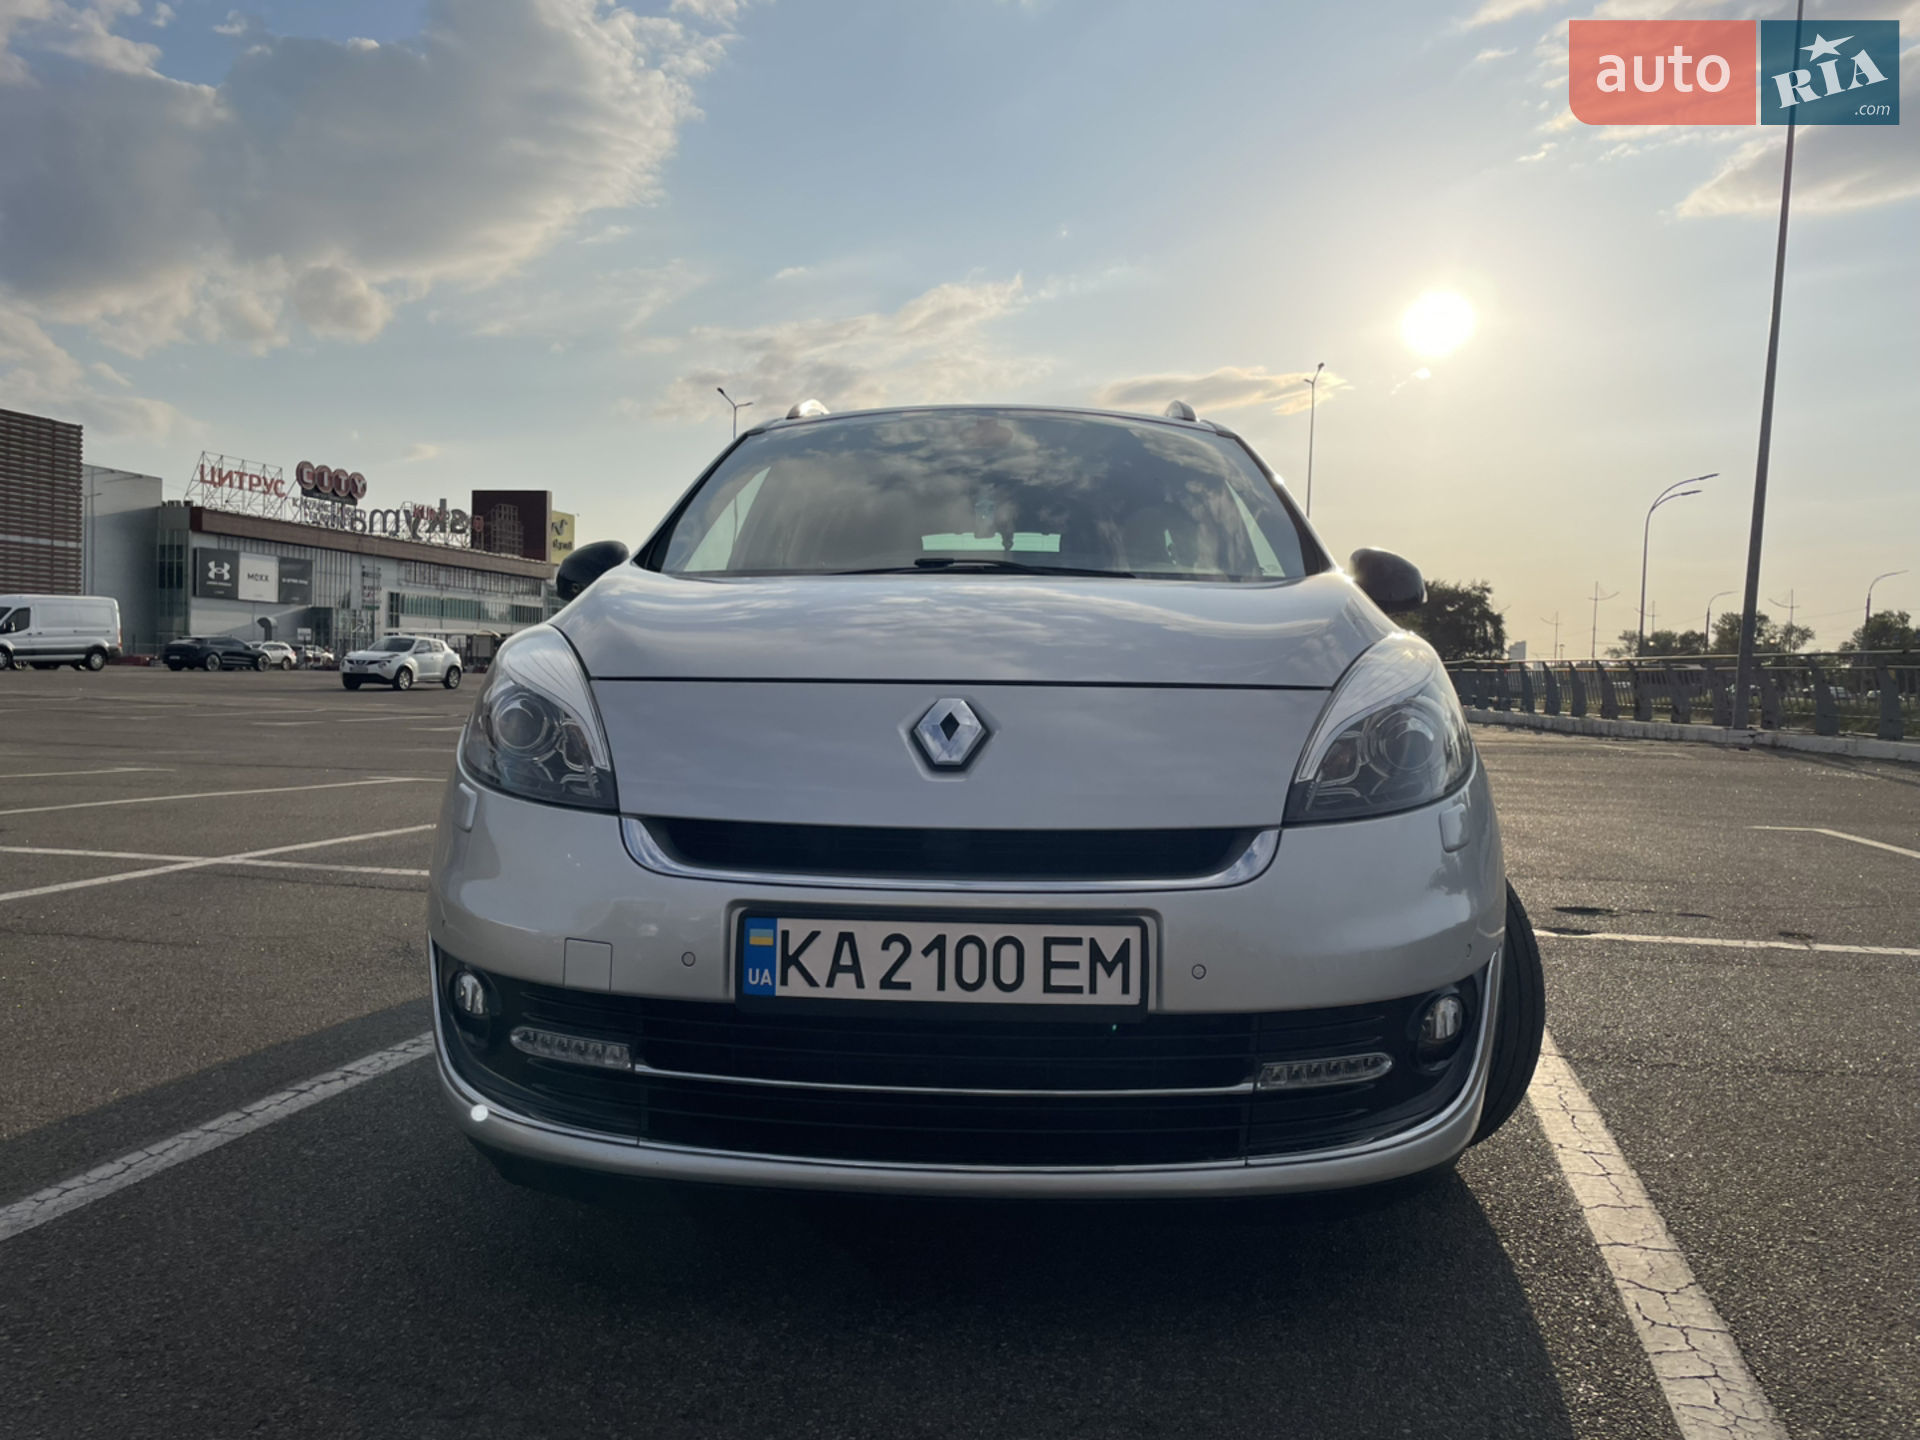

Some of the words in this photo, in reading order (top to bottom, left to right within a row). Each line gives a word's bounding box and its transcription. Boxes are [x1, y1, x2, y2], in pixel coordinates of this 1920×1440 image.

[200, 464, 286, 498] ЦИТРУС
[301, 466, 366, 495] CITY
[748, 968, 773, 986] UA
[779, 929, 865, 989] KA
[879, 932, 1025, 993] 2100
[1042, 936, 1131, 995] EM
